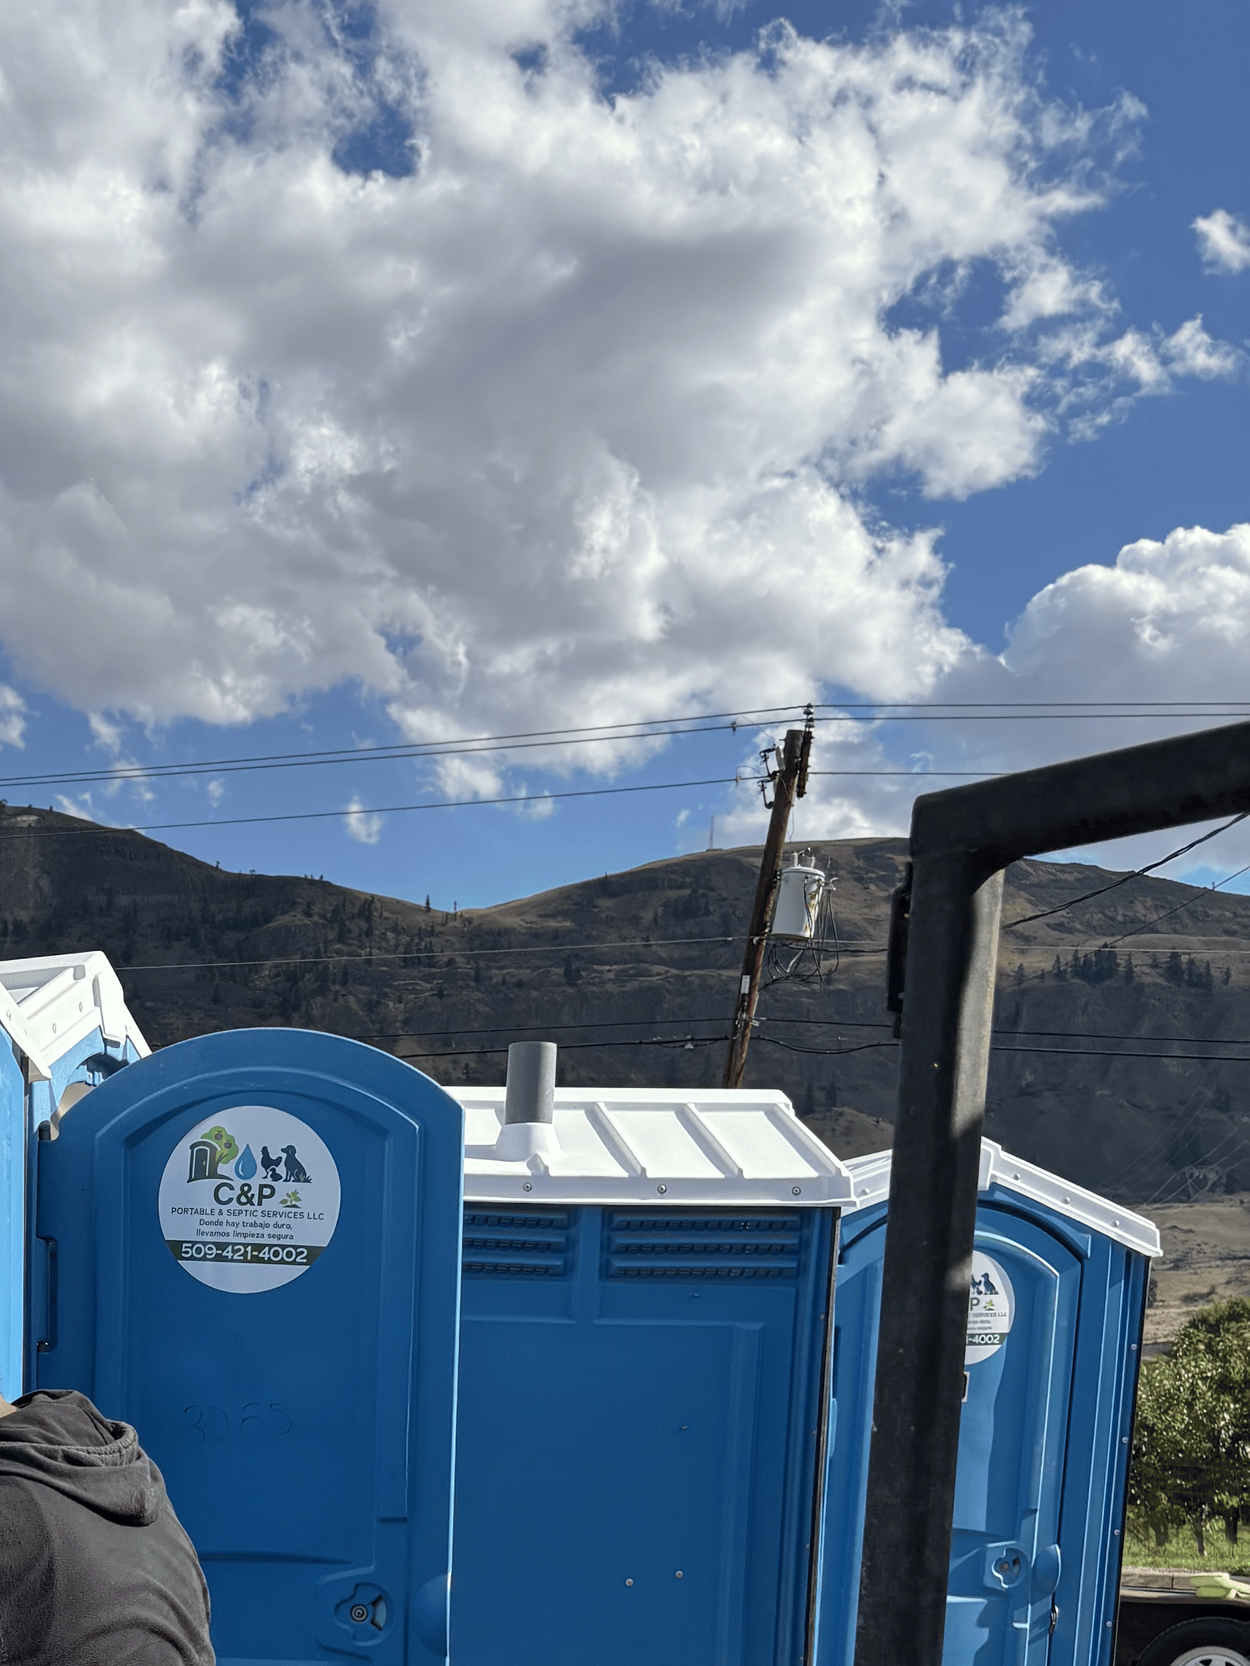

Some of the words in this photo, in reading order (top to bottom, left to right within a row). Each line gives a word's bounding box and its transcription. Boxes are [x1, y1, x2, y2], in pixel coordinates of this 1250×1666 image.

[213, 1182, 276, 1207] C&P
[171, 1207, 216, 1216] PORTABLE
[217, 1208, 223, 1216] &
[226, 1208, 259, 1218] SEPTIC
[260, 1209, 305, 1220] SERVICES
[307, 1211, 325, 1221] LLC
[199, 1218, 224, 1227] Donde
[225, 1219, 240, 1229] hay
[242, 1220, 271, 1230] trabajo
[195, 1228, 230, 1238] llevamos
[232, 1230, 265, 1240] limpieza
[267, 1232, 294, 1241] segura
[181, 1243, 308, 1263] 509-421-4002
